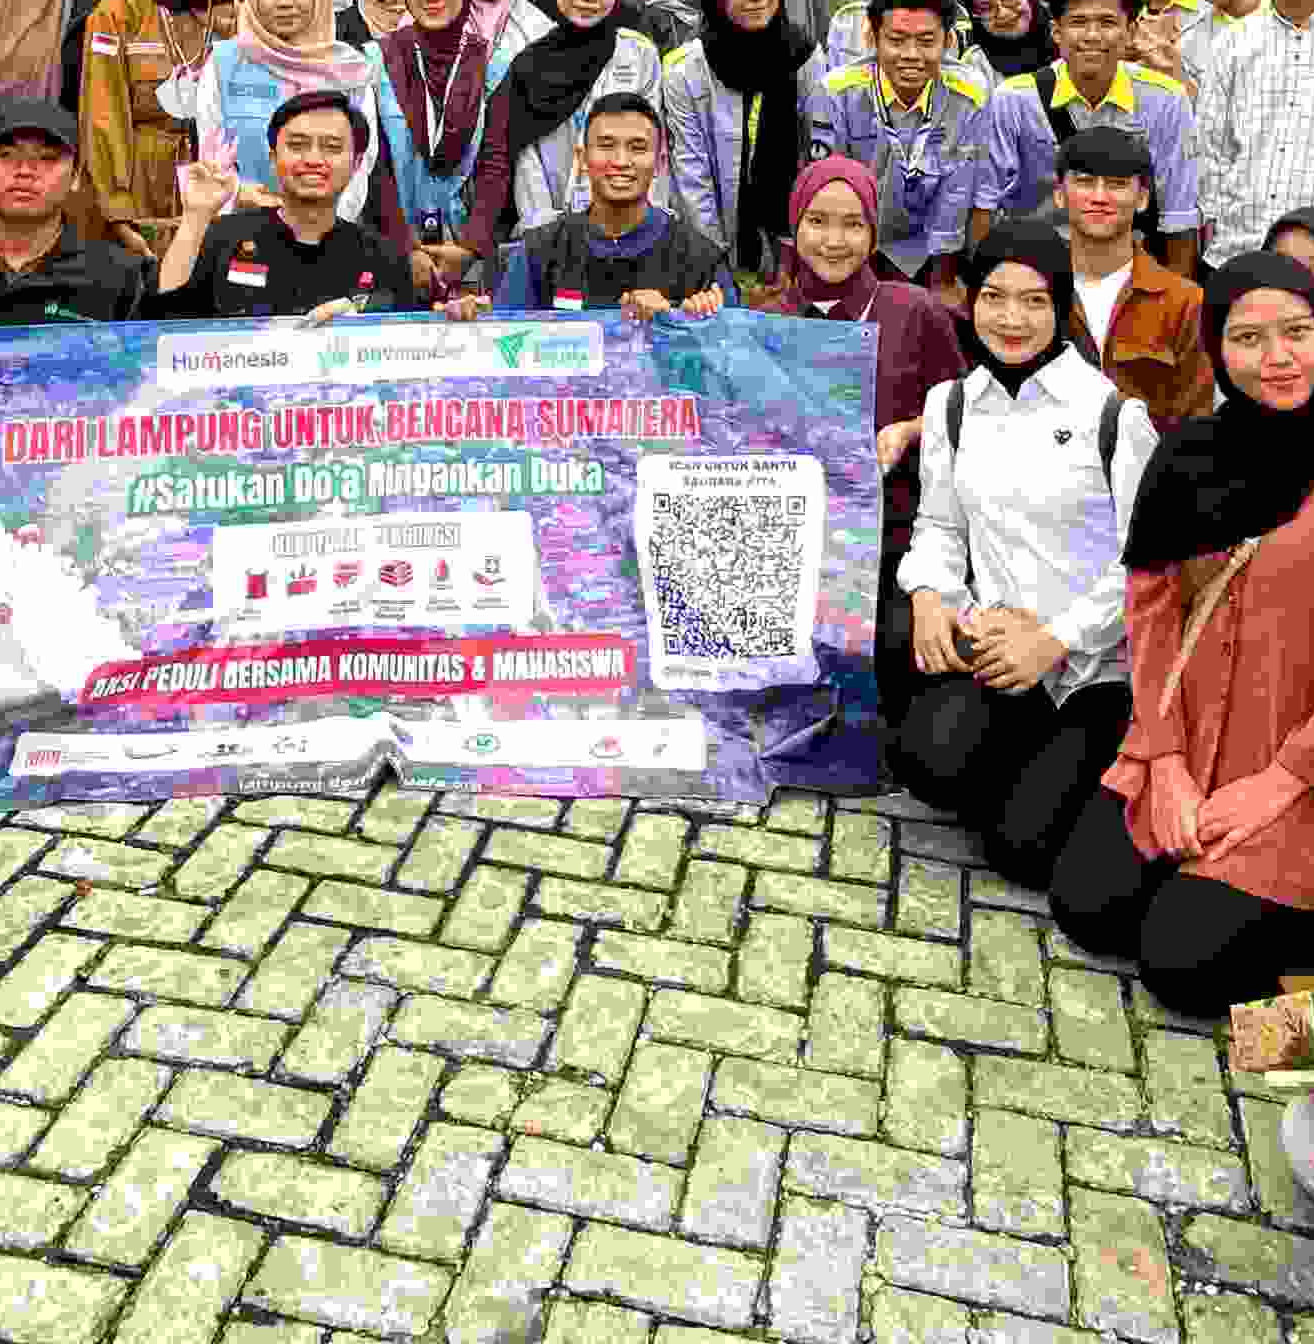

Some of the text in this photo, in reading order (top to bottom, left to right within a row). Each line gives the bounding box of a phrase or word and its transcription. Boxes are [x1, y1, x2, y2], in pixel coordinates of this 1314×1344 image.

[4, 397, 703, 464] DARI LAMPUNG UNTUK BENCANA SUMATERA
[142, 662, 220, 691] PEDULI
[223, 656, 332, 690] BERSAMA
[338, 653, 464, 681] KOMUNITAS
[492, 648, 625, 681] MAHASISWA
